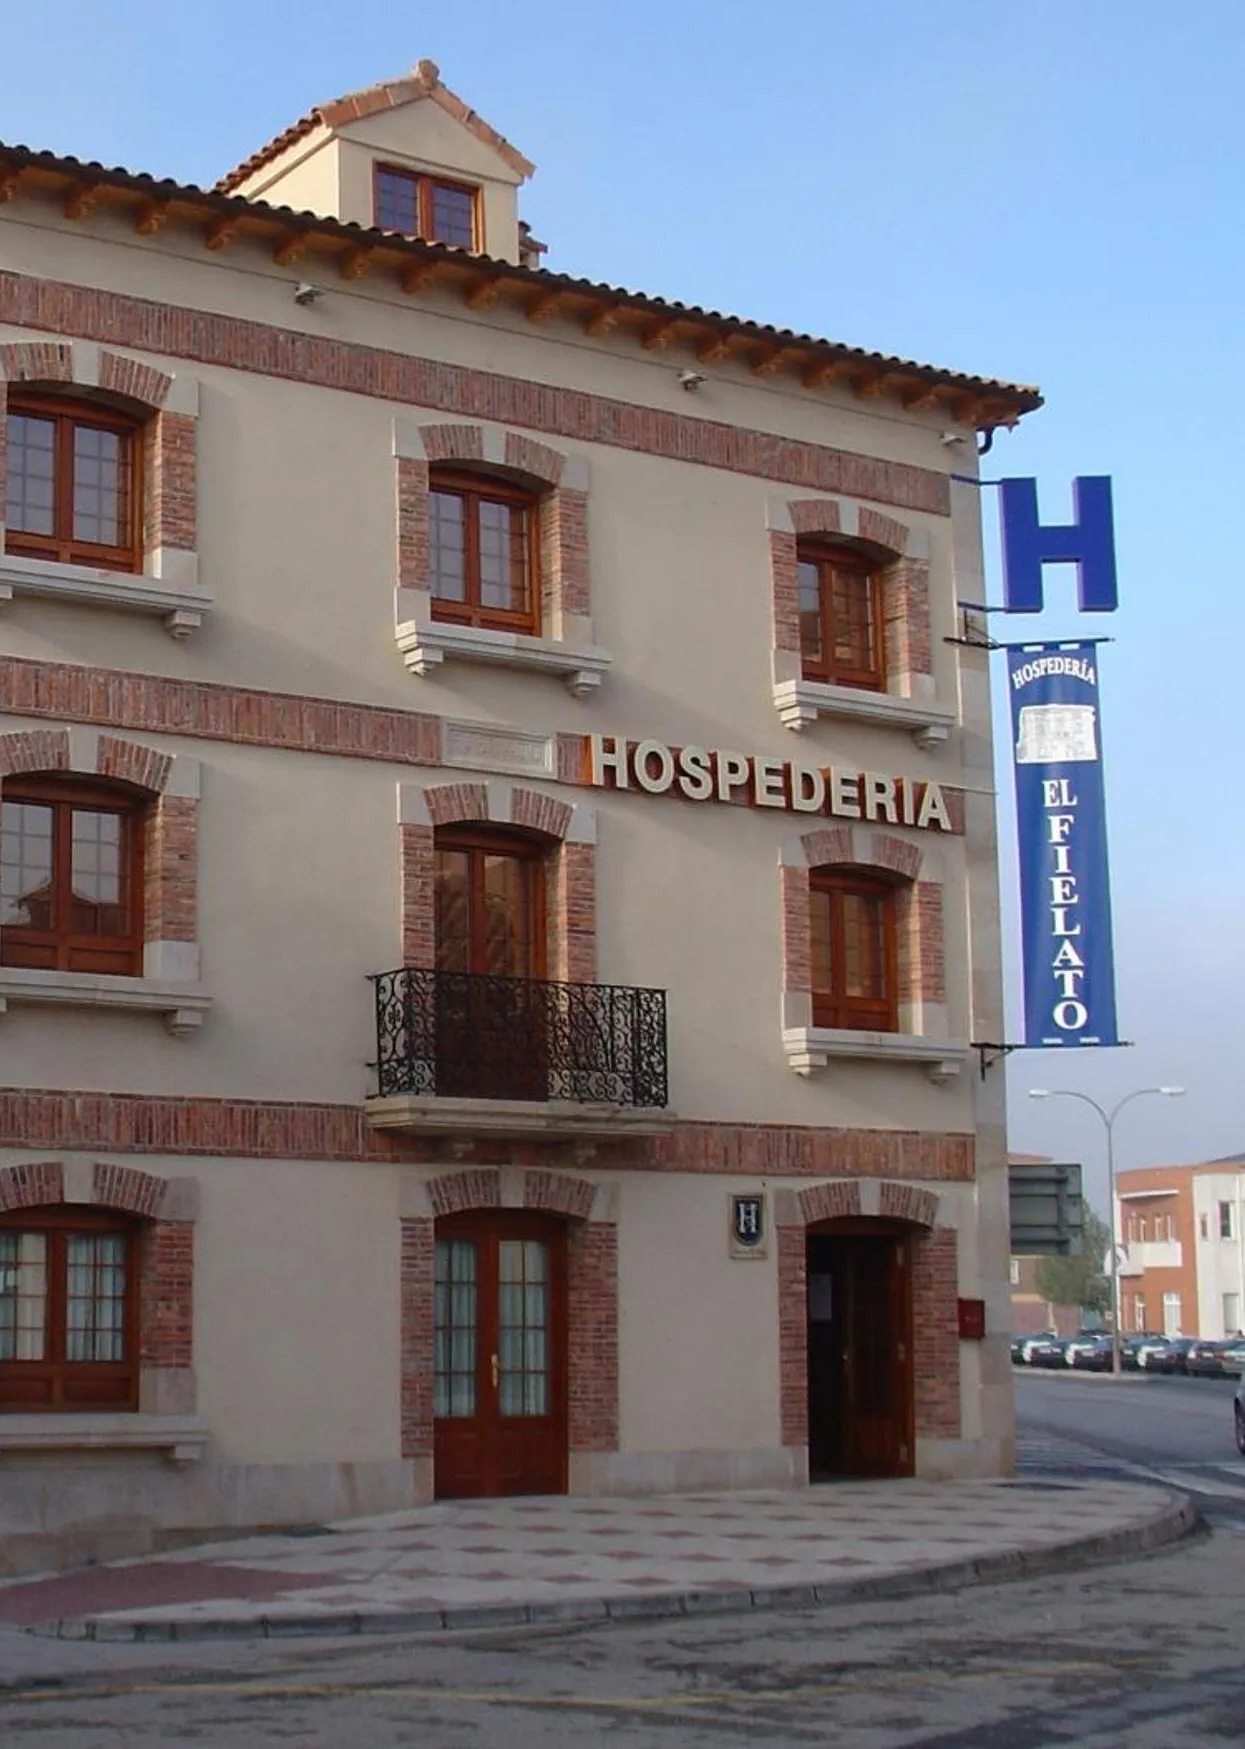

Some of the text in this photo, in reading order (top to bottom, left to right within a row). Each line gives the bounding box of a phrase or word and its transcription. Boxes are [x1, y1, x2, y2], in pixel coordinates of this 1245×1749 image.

[1001, 476, 1117, 612] H
[591, 733, 953, 831] HOSPEDERIA
[1042, 779, 1078, 807] EL
[1049, 815, 1087, 1030] FIELATO
